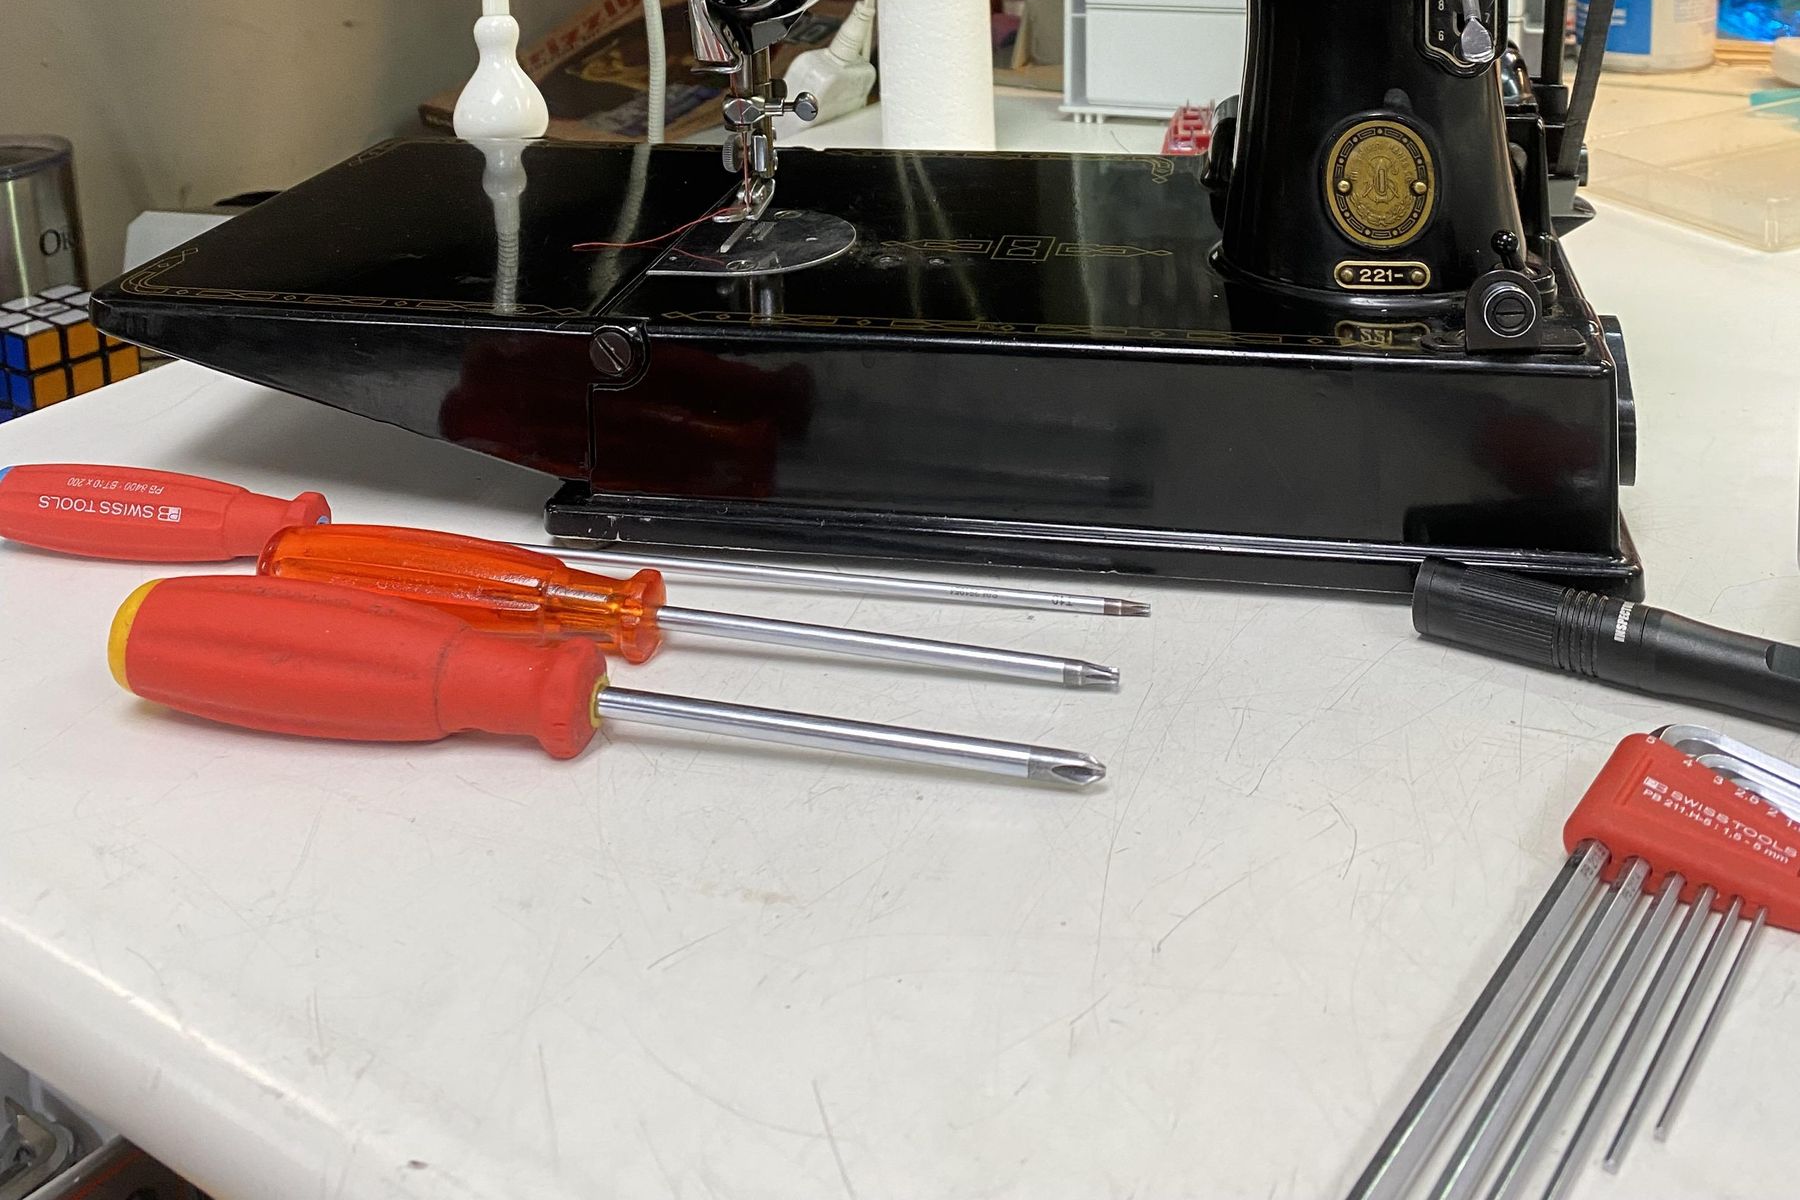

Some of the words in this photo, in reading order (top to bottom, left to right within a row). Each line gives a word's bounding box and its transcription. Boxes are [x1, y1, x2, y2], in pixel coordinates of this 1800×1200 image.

[1437, 0, 1445, 11] 8
[1484, 11, 1491, 23] 7
[1437, 30, 1445, 41] 6
[67, 477, 83, 487] 200
[38, 494, 96, 513] TOOLS
[99, 500, 154, 519] SWISS
[1683, 758, 1694, 768] 4
[1712, 775, 1724, 785] 3
[1766, 806, 1779, 818] 2
[1642, 788, 1662, 803] PB
[1763, 847, 1790, 864] mm
[1671, 790, 1730, 825] SWISS
[1732, 819, 1798, 858] TOOLS
